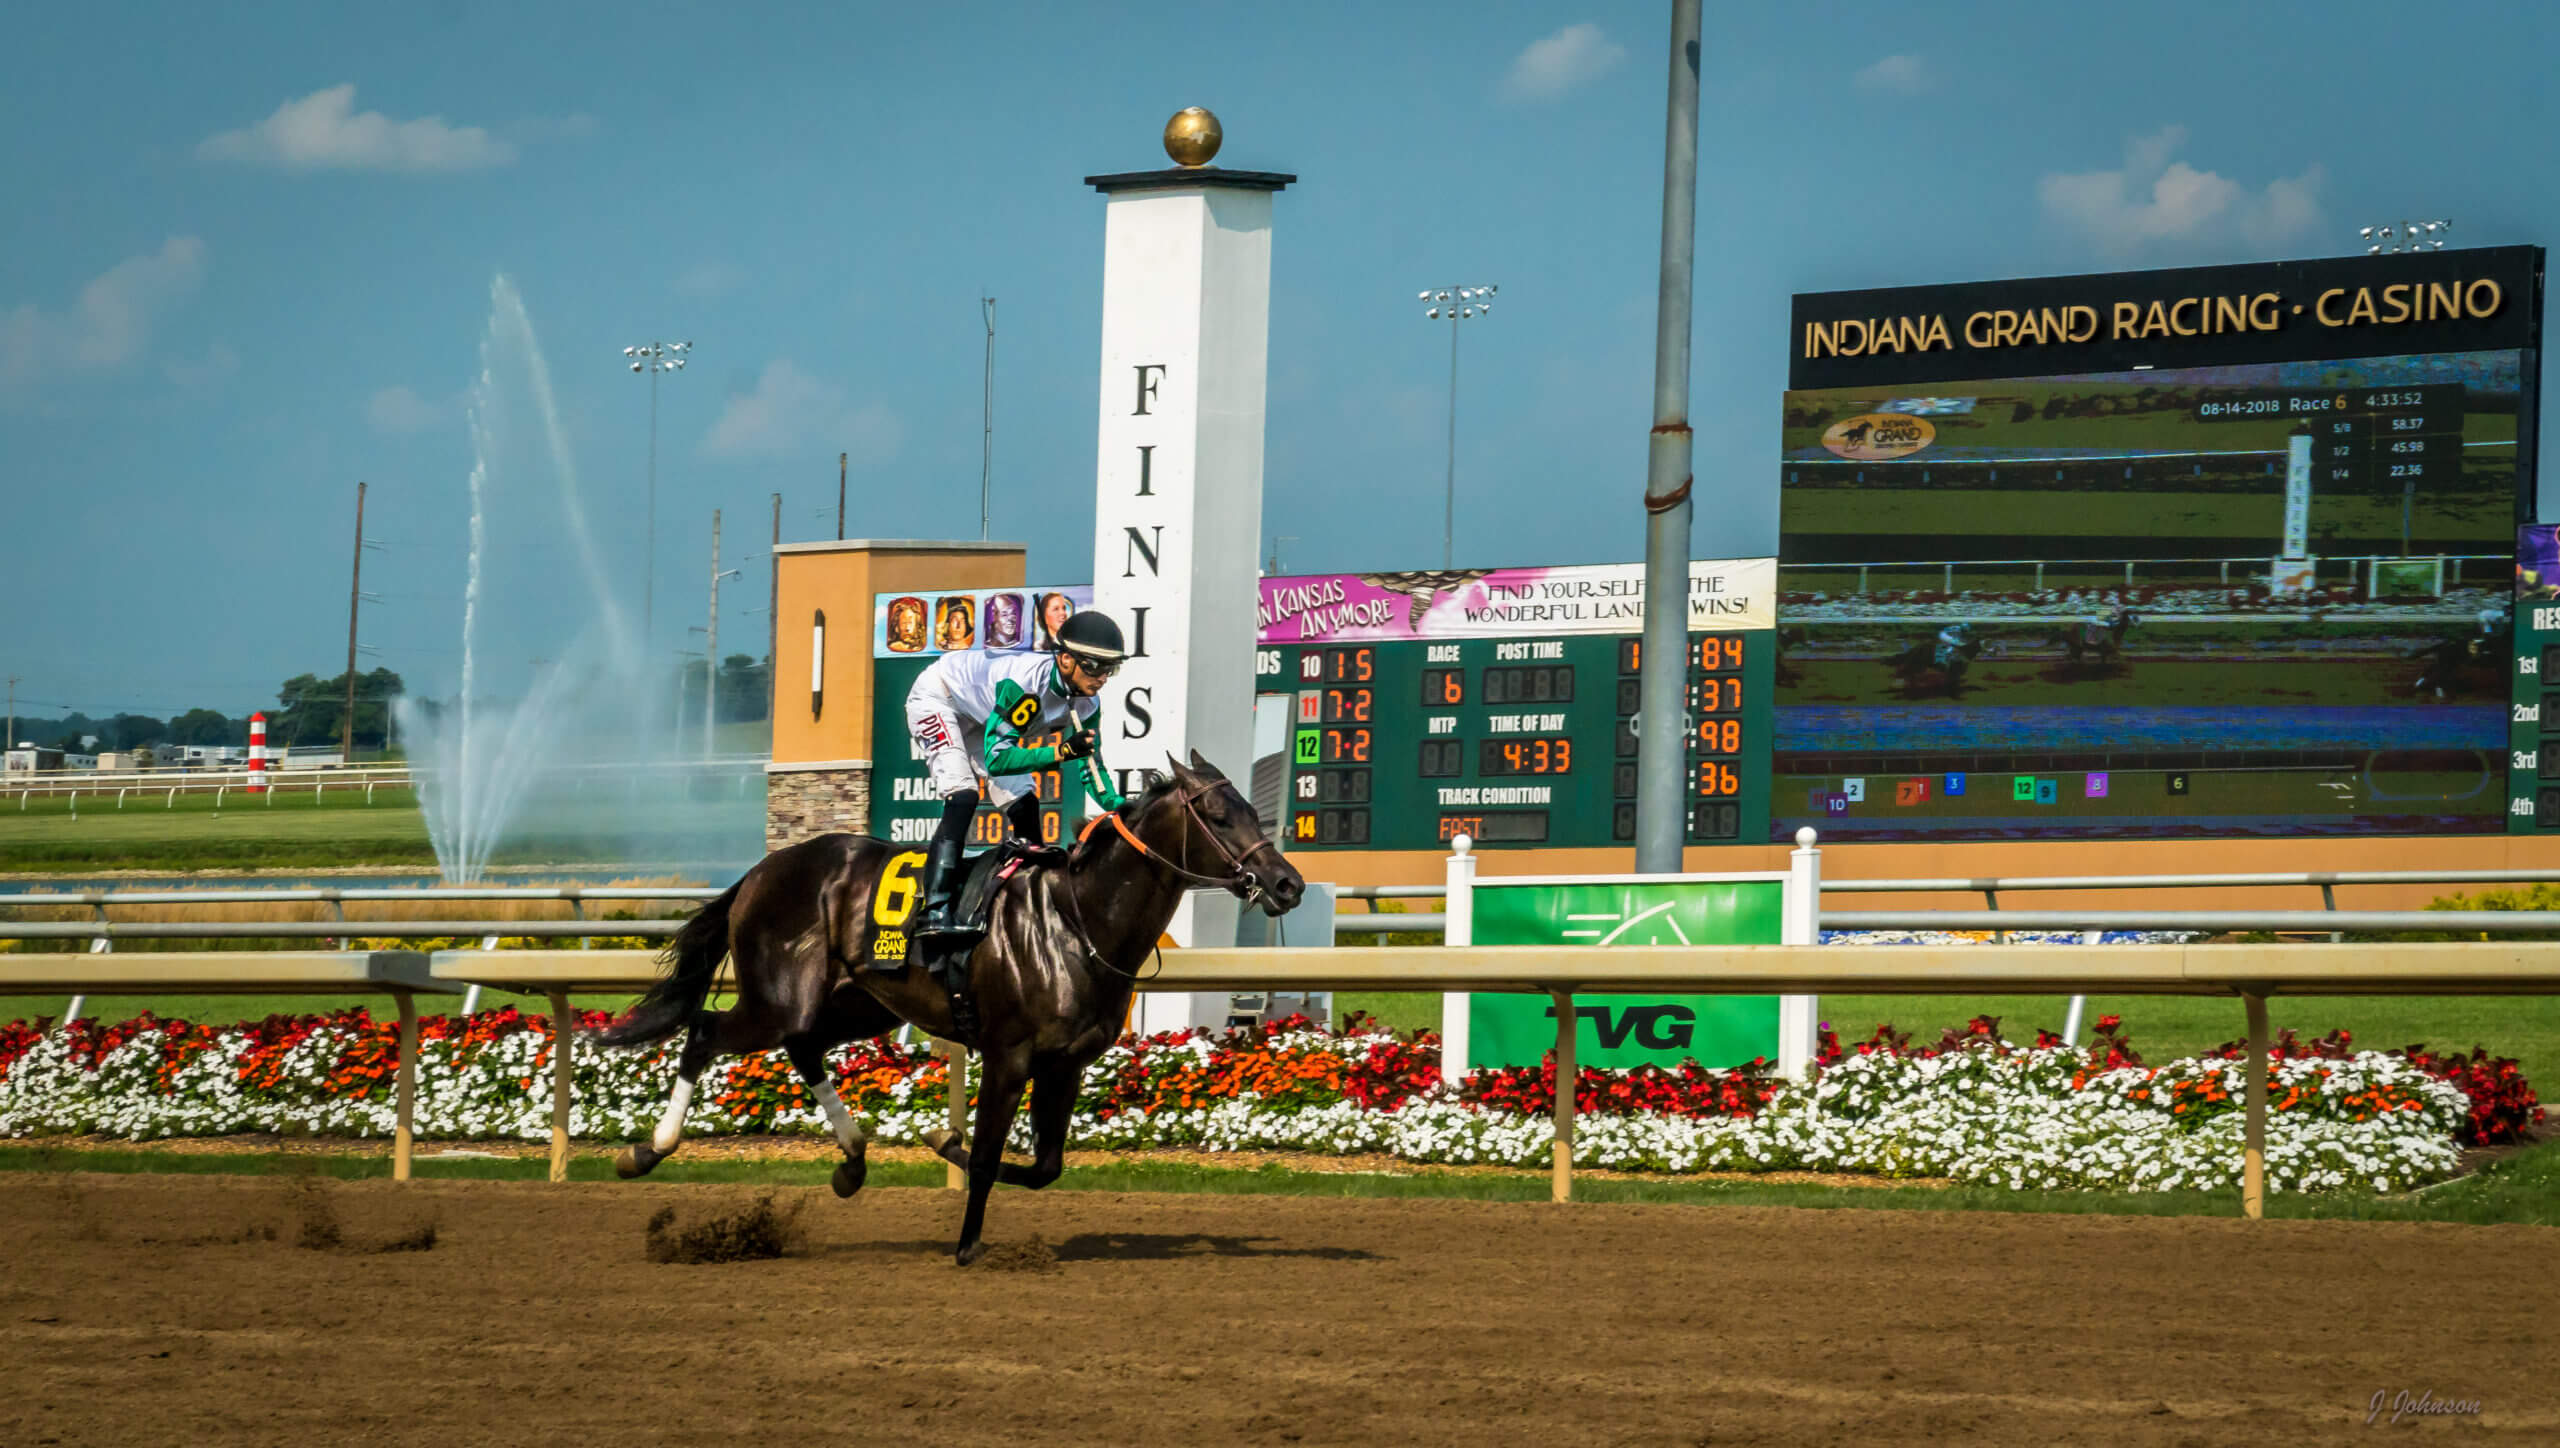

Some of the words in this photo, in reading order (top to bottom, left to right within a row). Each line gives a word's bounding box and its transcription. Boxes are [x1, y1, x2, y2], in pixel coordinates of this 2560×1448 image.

[1804, 314, 1953, 358] INDIANA
[1964, 305, 2098, 348] GRAND
[2112, 291, 2280, 340] RACING
[2315, 278, 2501, 327] CASINO
[2200, 400, 2280, 415] 08-14-2018
[2290, 397, 2330, 411] Race
[2335, 394, 2347, 410] 6
[2365, 392, 2423, 407] 4:33:52
[2392, 417, 2424, 431] 58.37
[1873, 427, 1922, 443] GRAND
[2391, 441, 2425, 454] 45.98
[2389, 464, 2423, 477] 22.36
[1272, 579, 1345, 622] KANSAS
[1487, 584, 1534, 601] FIND
[1300, 599, 1395, 639] ANYMORE
[1463, 602, 1588, 623] WONDERFUL
[1691, 597, 1749, 615] WINS!
[1427, 645, 1460, 662] RACE
[1496, 643, 1530, 660] POST
[1532, 641, 1564, 659] TIME
[1301, 655, 1321, 678] 10
[2517, 656, 2538, 675] 1st
[1444, 673, 1462, 704] 6
[1012, 698, 1037, 726] 6
[1301, 695, 1318, 717] 11
[2513, 703, 2539, 722] 2nd
[1428, 717, 1457, 734] MTP
[1489, 715, 1521, 733] TIME
[1522, 714, 1539, 732] OF
[1539, 714, 1566, 731] DAY
[1298, 736, 1317, 757] 12
[1503, 739, 1570, 773] 4:33
[2513, 750, 2536, 769] 3rd
[1296, 775, 1317, 798] 13
[1850, 784, 1858, 796] 2
[1903, 787, 1911, 799] 7
[1951, 778, 1959, 790] 3
[2017, 782, 2031, 794] 12
[2041, 786, 2050, 798] 9
[2173, 777, 2183, 790] 6
[1438, 788, 1480, 805] TRACK
[1481, 786, 1551, 804] CONDITION
[1829, 799, 1846, 811] 10
[2511, 797, 2534, 816] 4th
[1295, 815, 1316, 838] 14
[1439, 817, 1482, 840] FAST
[873, 850, 928, 926] 6
